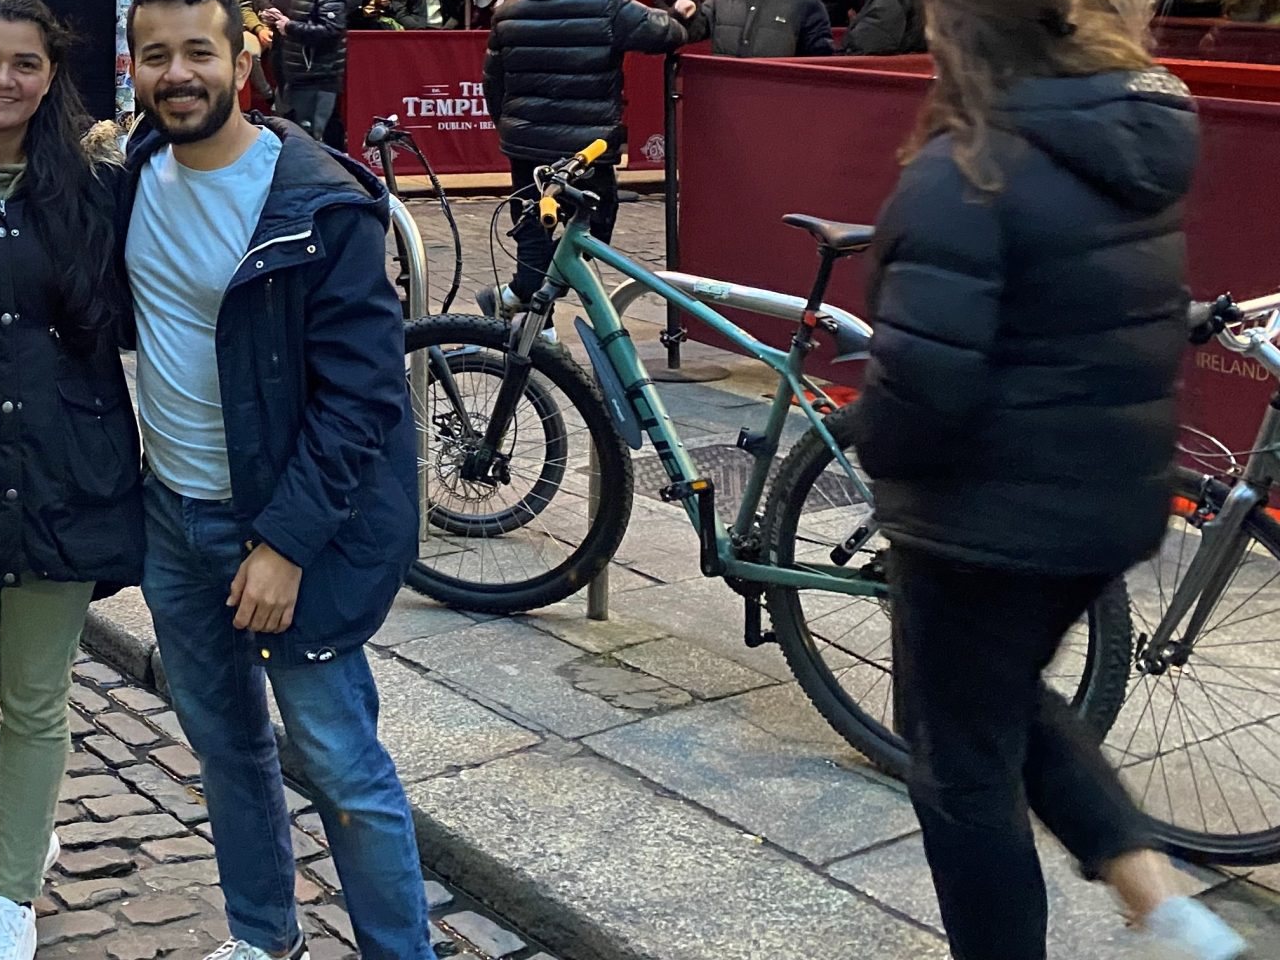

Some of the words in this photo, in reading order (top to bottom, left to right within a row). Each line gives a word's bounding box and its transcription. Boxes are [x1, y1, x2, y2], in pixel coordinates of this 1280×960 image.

[459, 82, 484, 97] TH
[438, 122, 472, 130] DUBLIN
[1195, 352, 1270, 381] IRELAND
